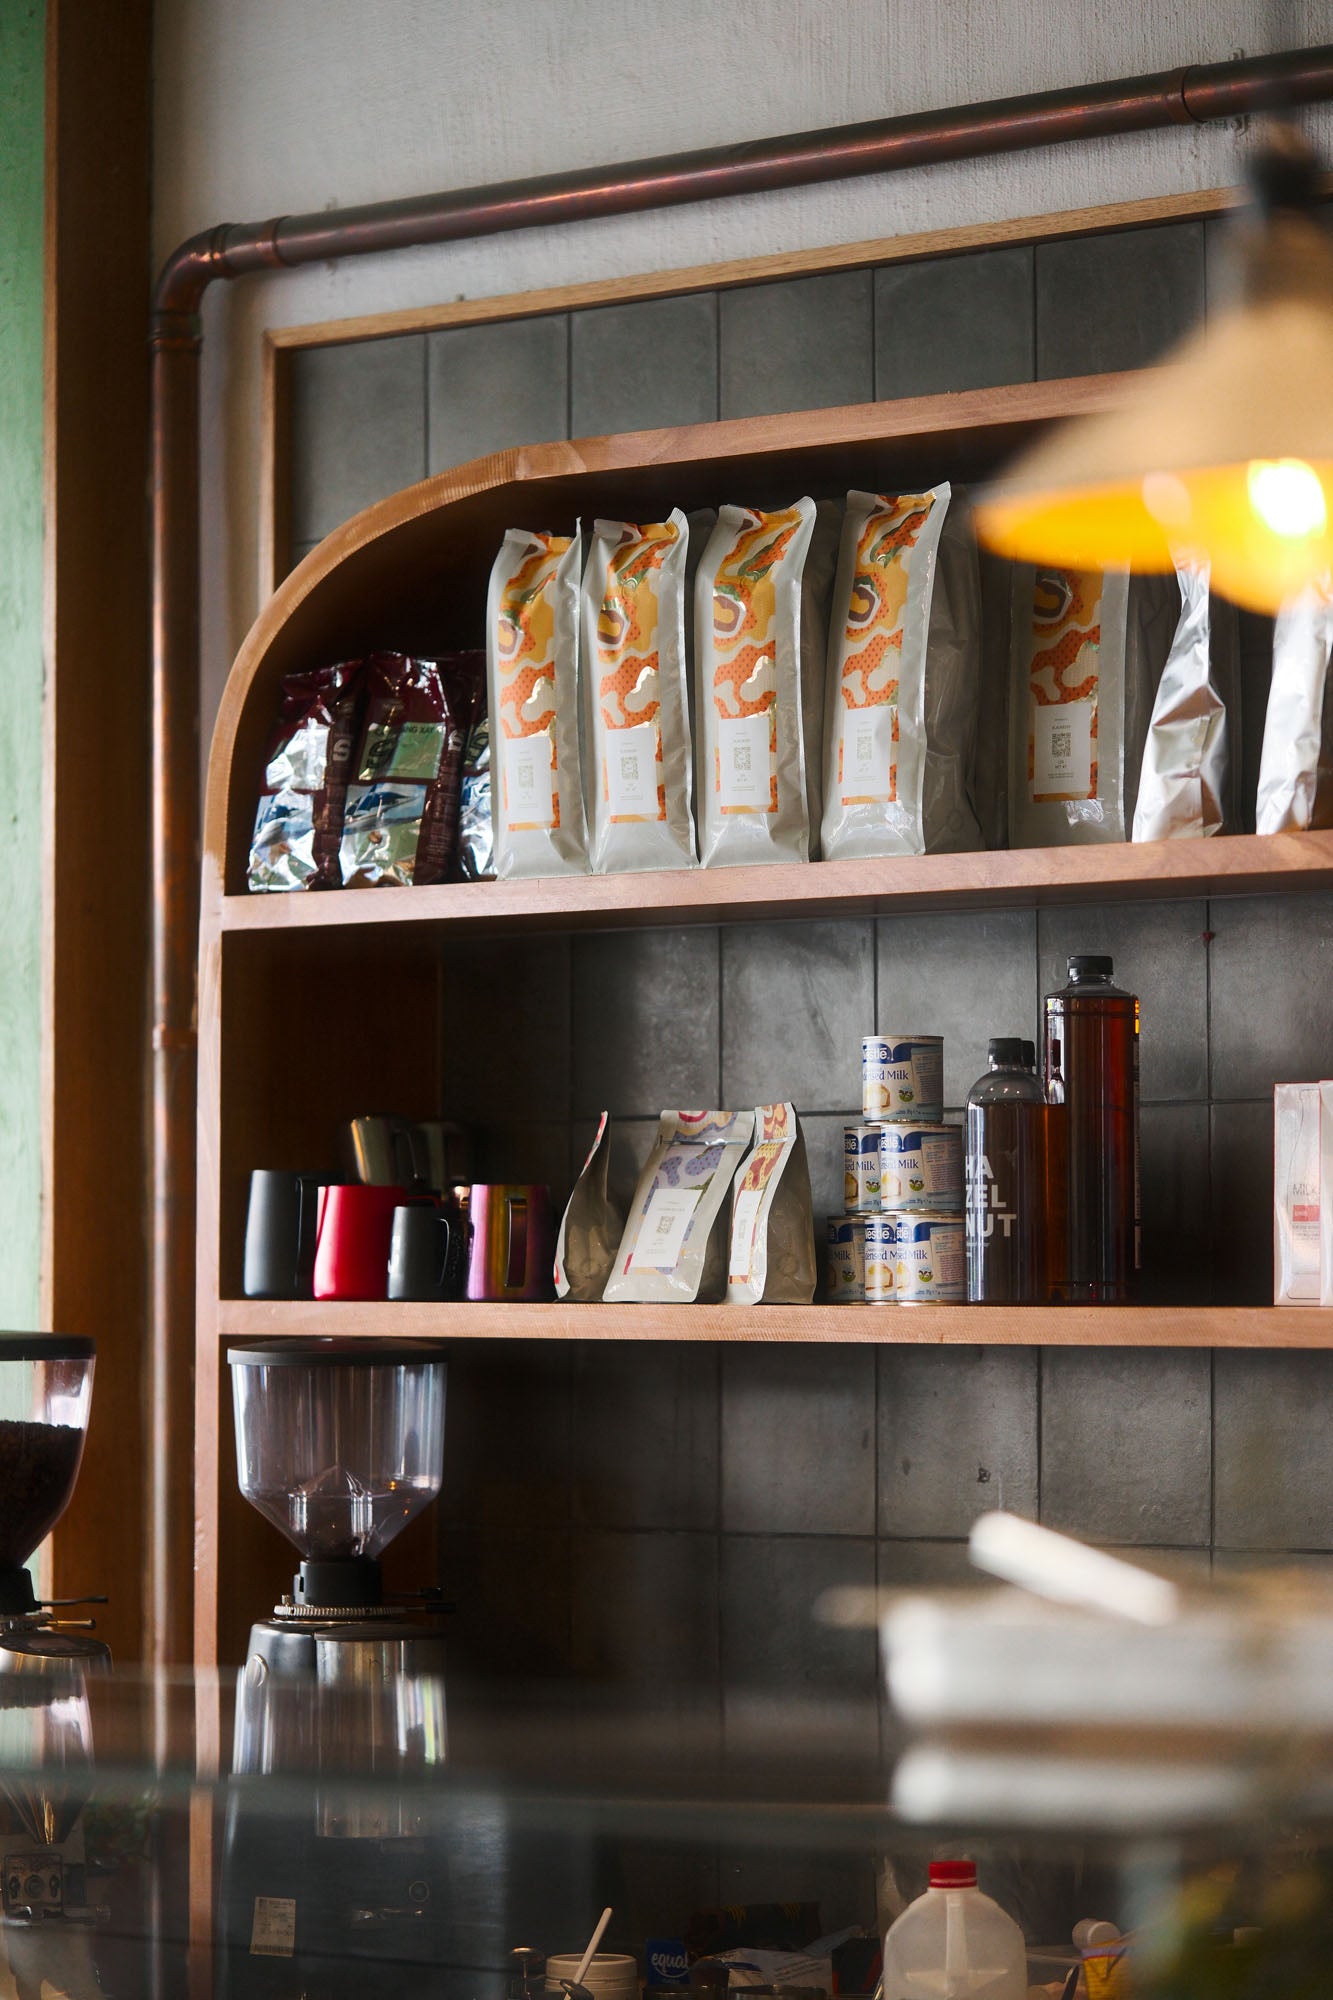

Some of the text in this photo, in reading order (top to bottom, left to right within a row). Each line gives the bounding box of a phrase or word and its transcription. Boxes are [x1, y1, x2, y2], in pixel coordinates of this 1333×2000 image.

[887, 1069, 909, 1081] Milk
[856, 1160, 876, 1171] Milk
[898, 1158, 919, 1169] Milk
[965, 1184, 1007, 1208] ZEL
[965, 1213, 1017, 1238] NUT
[834, 1249, 851, 1261] Milk
[651, 1951, 689, 1974] equal
